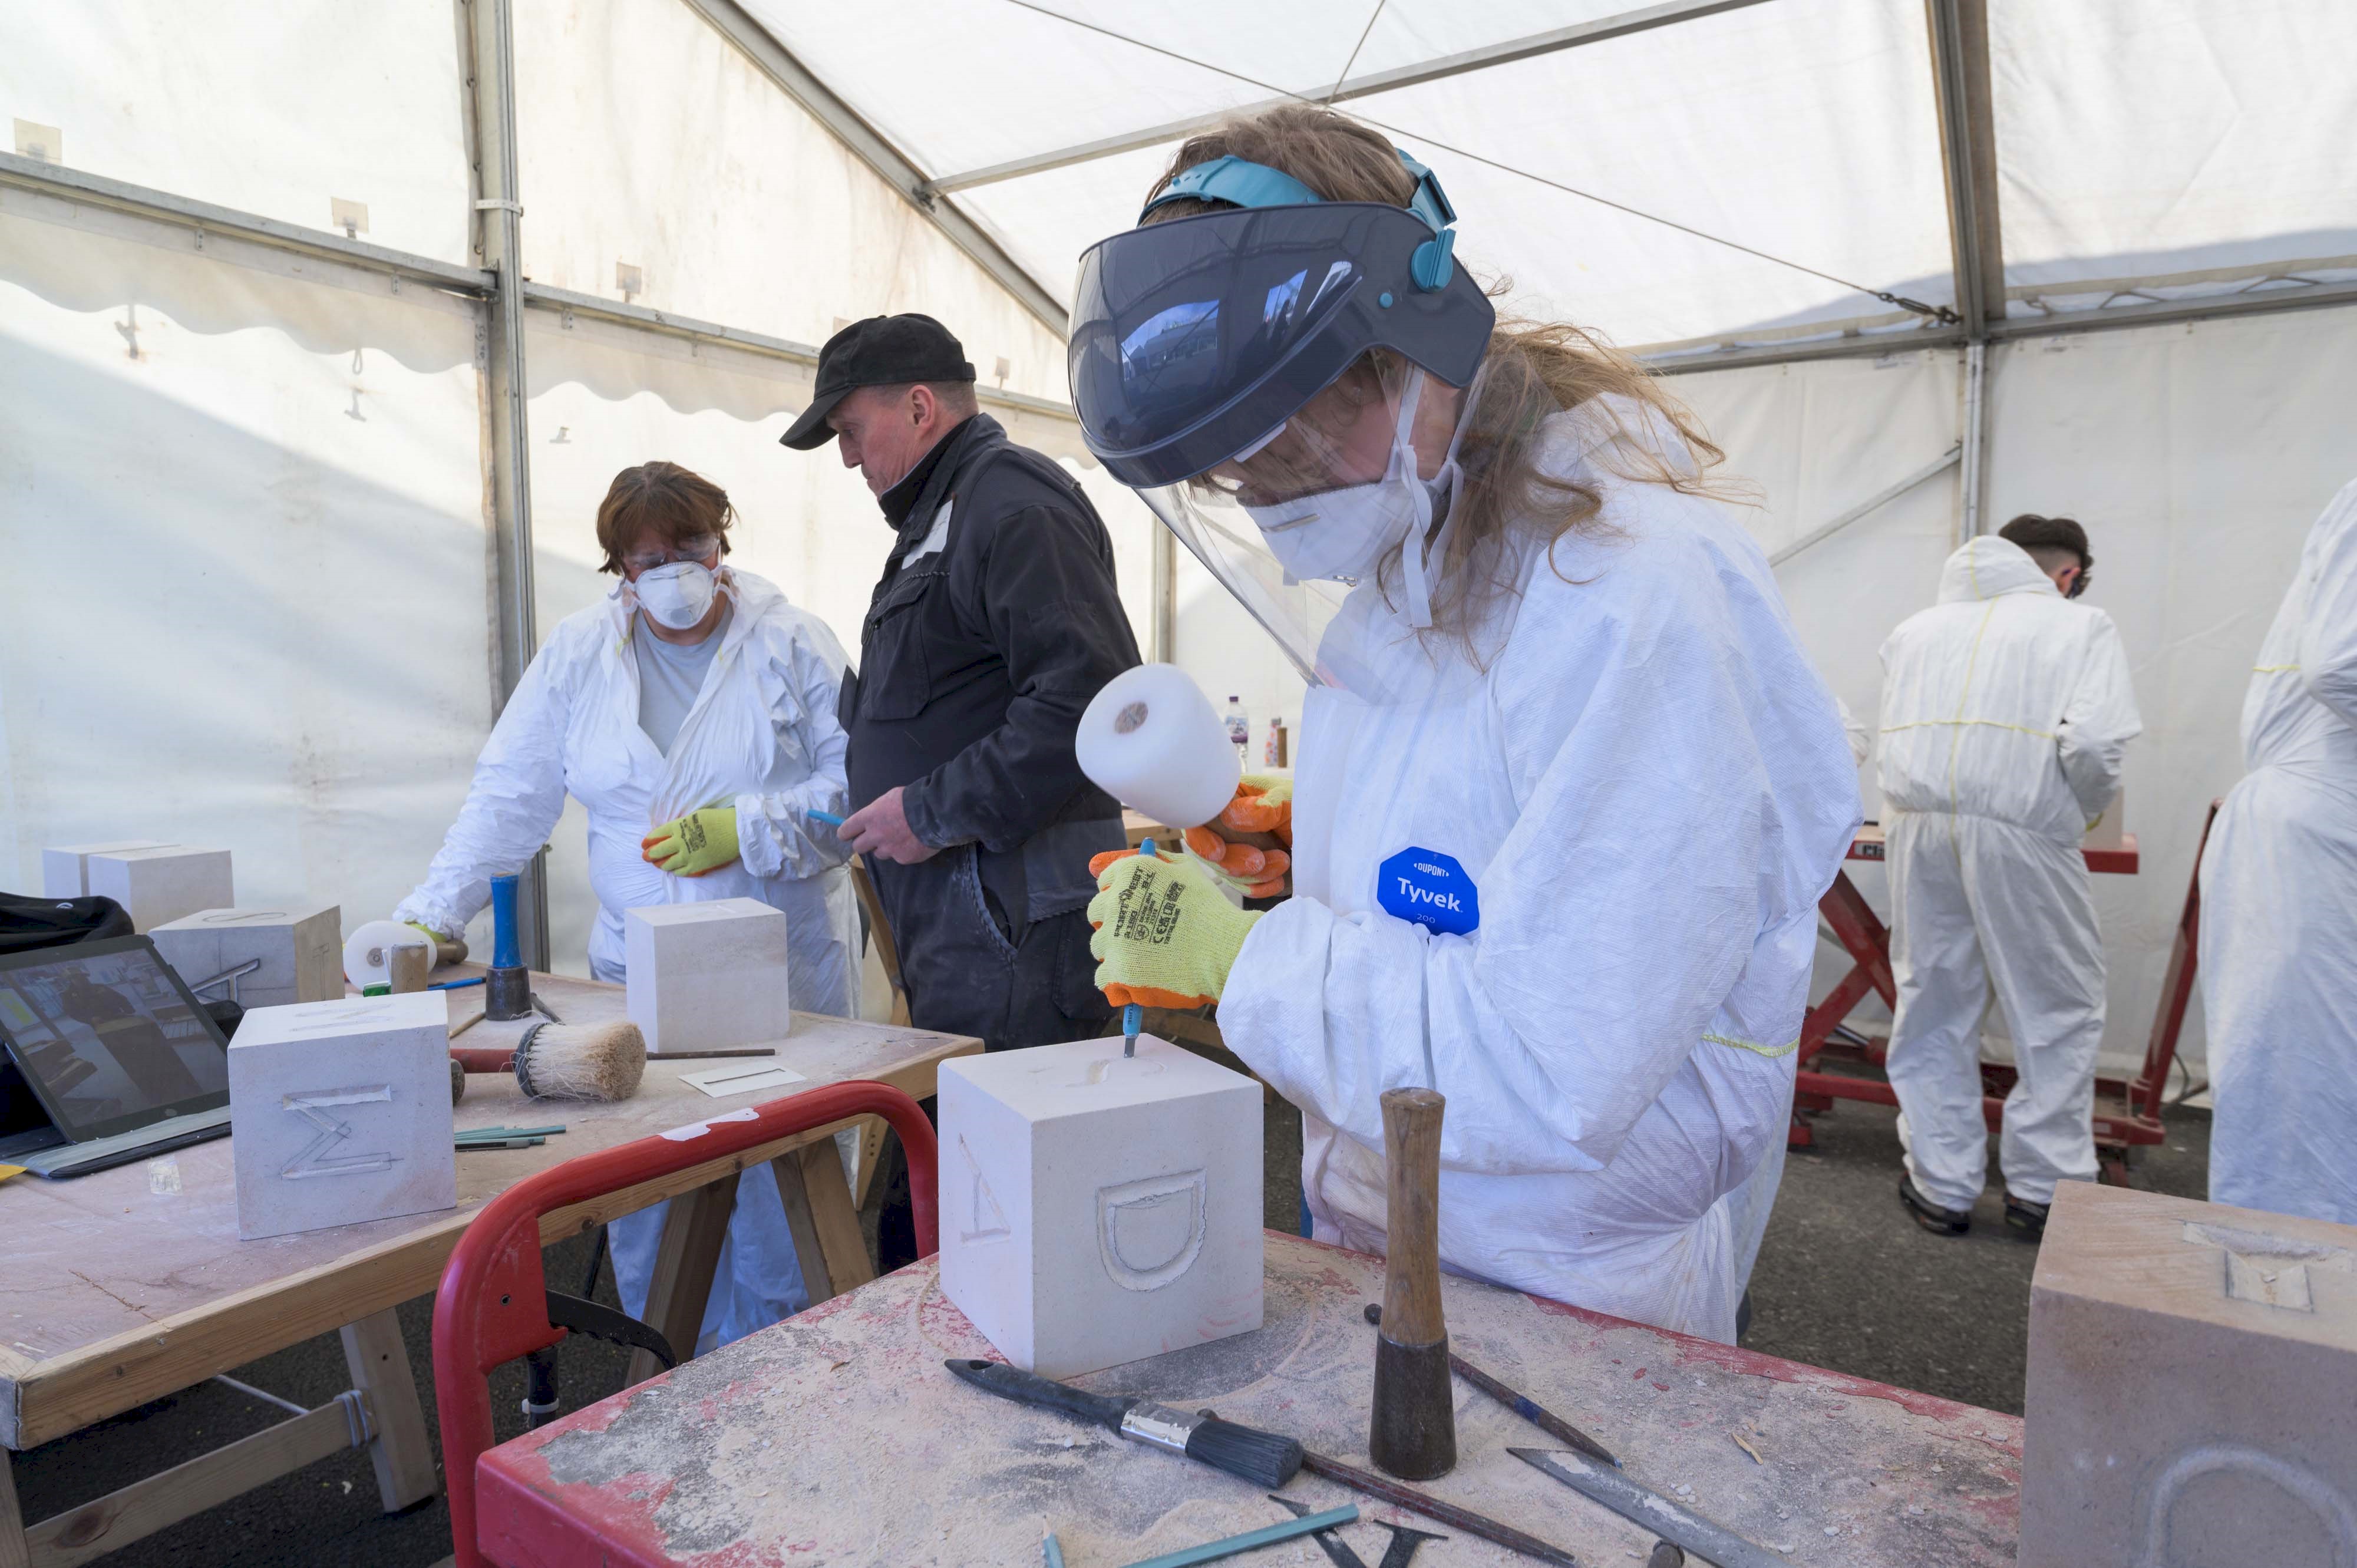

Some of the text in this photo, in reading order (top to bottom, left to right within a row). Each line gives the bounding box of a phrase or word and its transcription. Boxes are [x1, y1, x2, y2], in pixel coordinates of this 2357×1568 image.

[1418, 863, 1445, 877] DUPONT
[1397, 877, 1460, 912] Tyvek
[1417, 913, 1435, 924] 200
